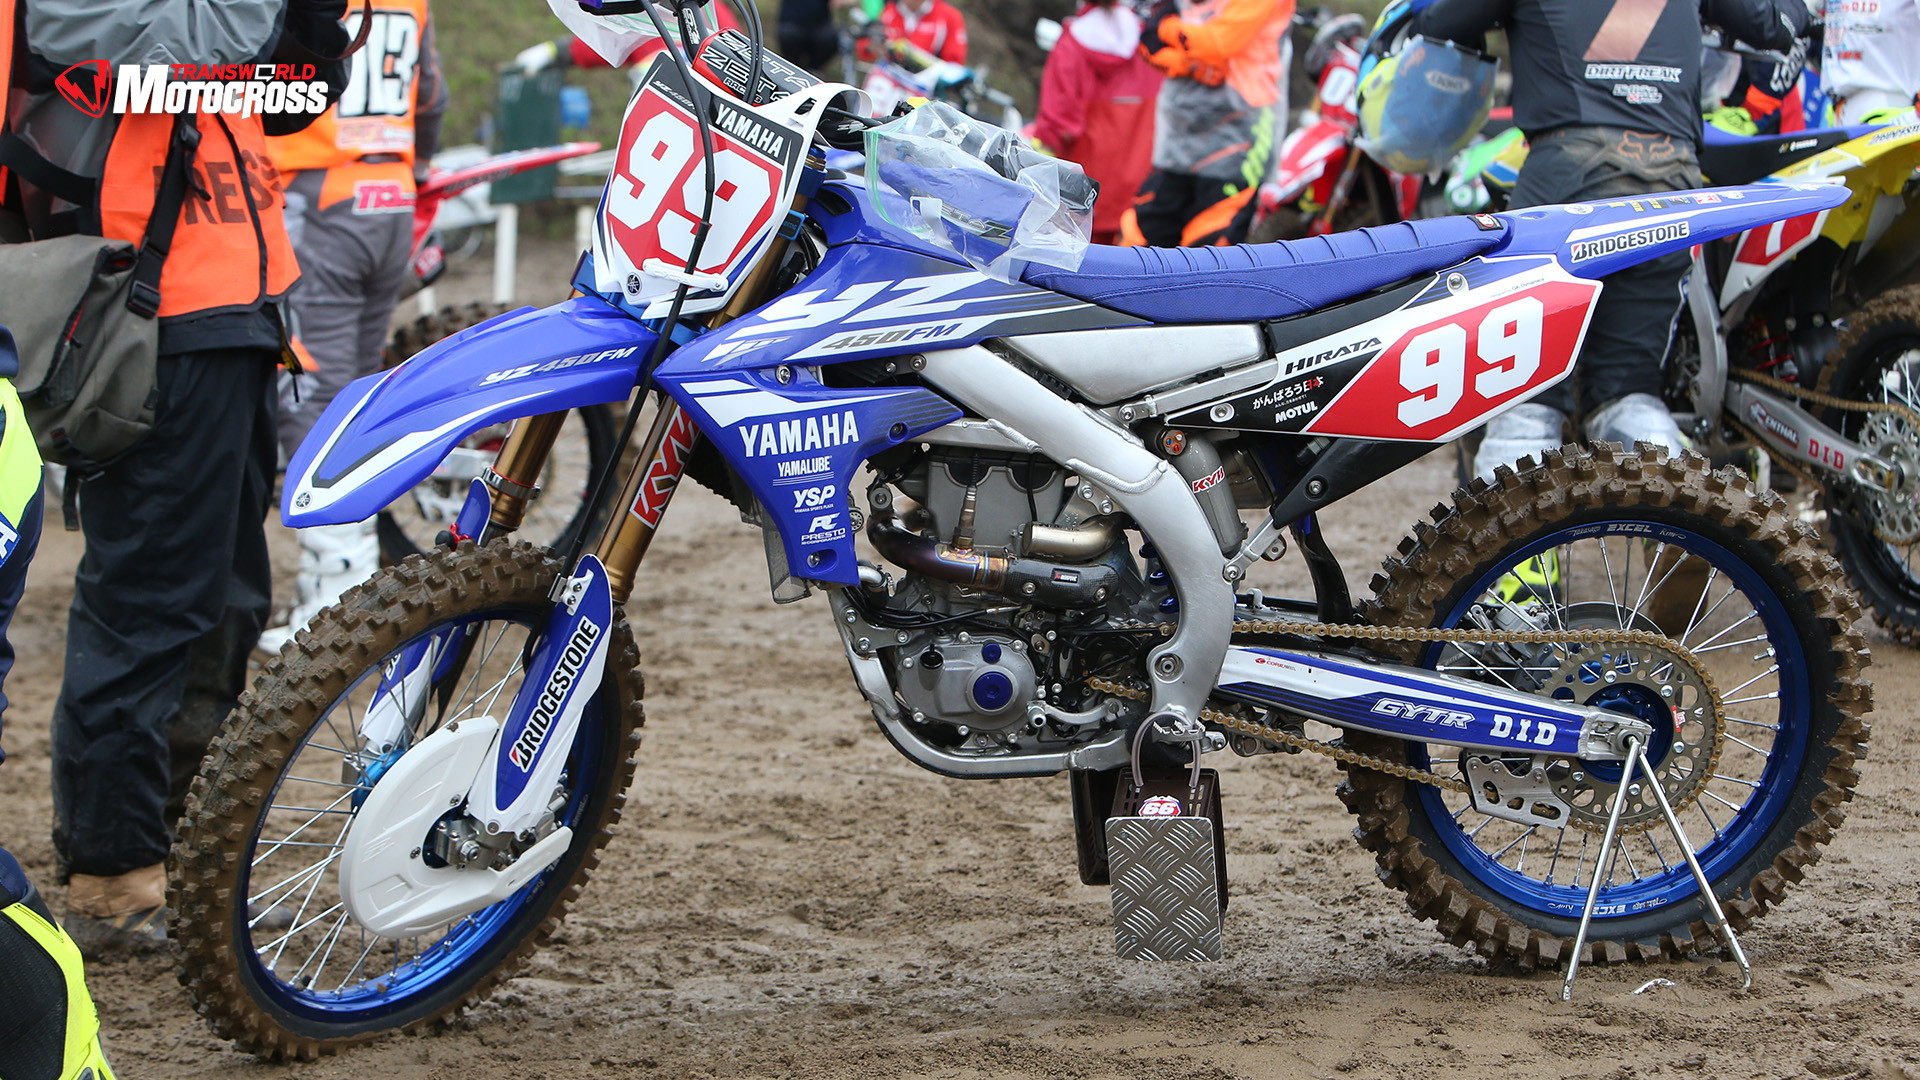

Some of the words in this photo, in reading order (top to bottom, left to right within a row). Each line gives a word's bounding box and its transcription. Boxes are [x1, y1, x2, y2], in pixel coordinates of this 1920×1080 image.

[715, 103, 784, 158] YAMAHA
[608, 110, 772, 271] 99
[1571, 222, 1688, 263] BRIDGESTONE
[822, 323, 962, 349] 450FM
[1285, 337, 1382, 375] HIRATA
[1397, 296, 1544, 428] 99
[1252, 376, 1324, 410] がんばろう日本
[1275, 401, 1318, 423] MOTUL
[738, 411, 859, 457] YAMAHA
[778, 456, 831, 477] YAMALUBE
[1192, 466, 1225, 493] KYB
[793, 485, 836, 508] YSP
[801, 528, 846, 541] PRESTO
[1606, 524, 1652, 533] EXCEL
[510, 618, 599, 772] BRIDGESTONE
[1371, 697, 1475, 729] GYTR
[1142, 802, 1177, 815] 66
